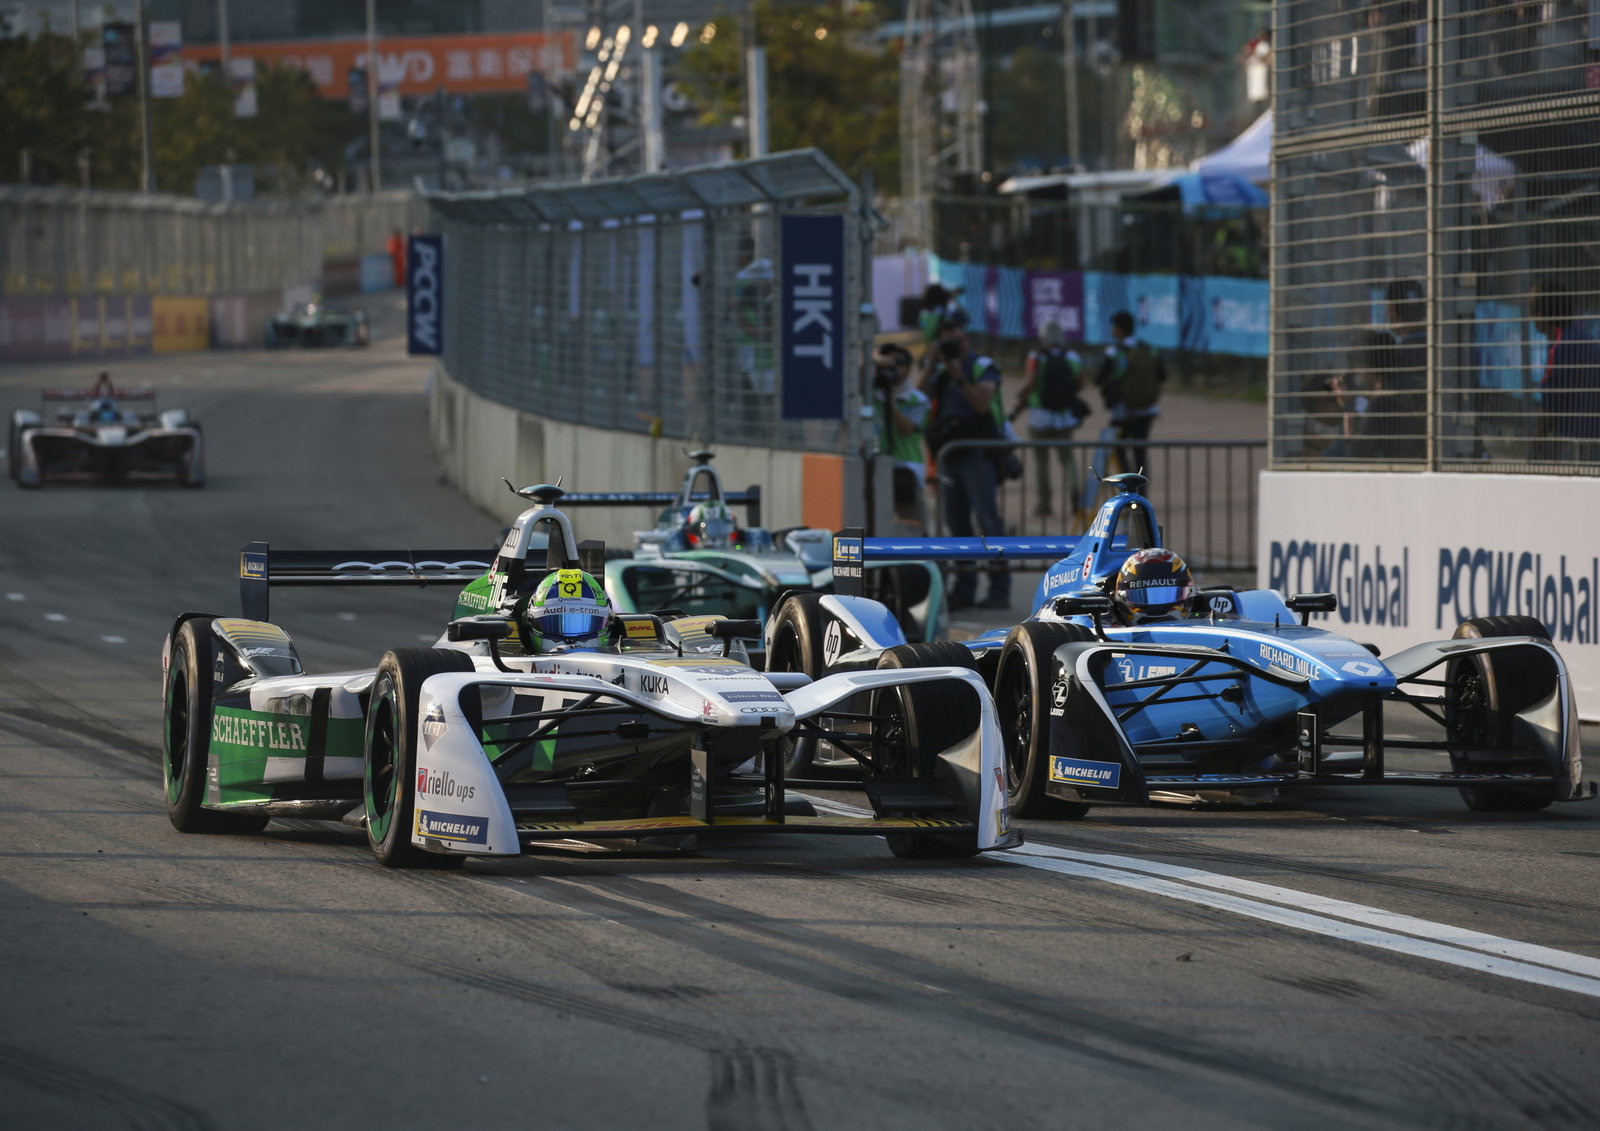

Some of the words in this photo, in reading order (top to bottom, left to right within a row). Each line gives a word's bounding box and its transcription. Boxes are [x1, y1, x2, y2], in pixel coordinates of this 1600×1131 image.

[414, 241, 437, 350] PCCW
[793, 264, 832, 370] HKT
[1049, 568, 1080, 589] RENAULT
[1129, 578, 1177, 588] RENAULT
[543, 606, 567, 615] Audi
[569, 606, 600, 615] e-tron
[1259, 643, 1294, 669] RICHARD
[1296, 657, 1321, 680] MILLE
[640, 674, 670, 695] KUKA
[213, 714, 306, 750] SCHAEFFLER
[1064, 766, 1112, 780] MICHELIN
[428, 770, 455, 797] riello
[457, 784, 475, 803] ups
[430, 820, 480, 836] MICHELIN
